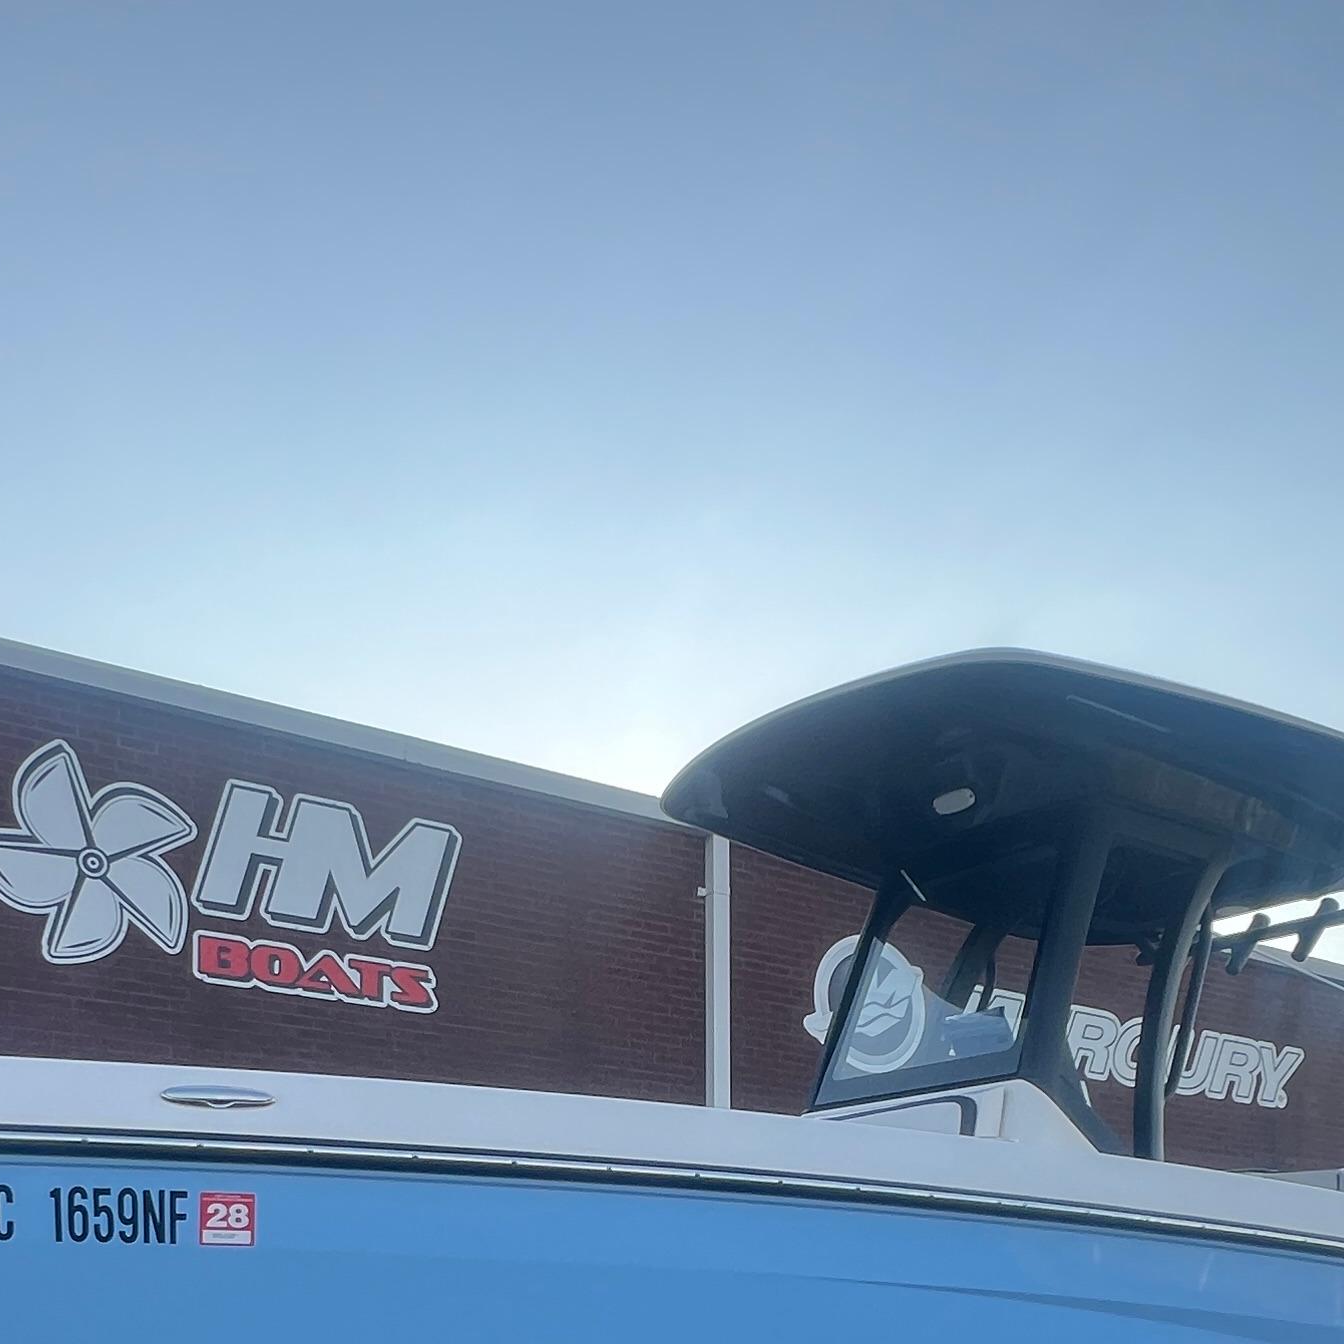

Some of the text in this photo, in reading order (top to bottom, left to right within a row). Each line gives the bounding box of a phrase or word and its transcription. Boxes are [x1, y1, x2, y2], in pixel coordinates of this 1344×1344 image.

[192, 779, 462, 950] HM
[193, 930, 438, 1013] BOATS
[947, 984, 1305, 1108] RCURY
[49, 1186, 188, 1244] 1659NF
[206, 1203, 249, 1229] 28
